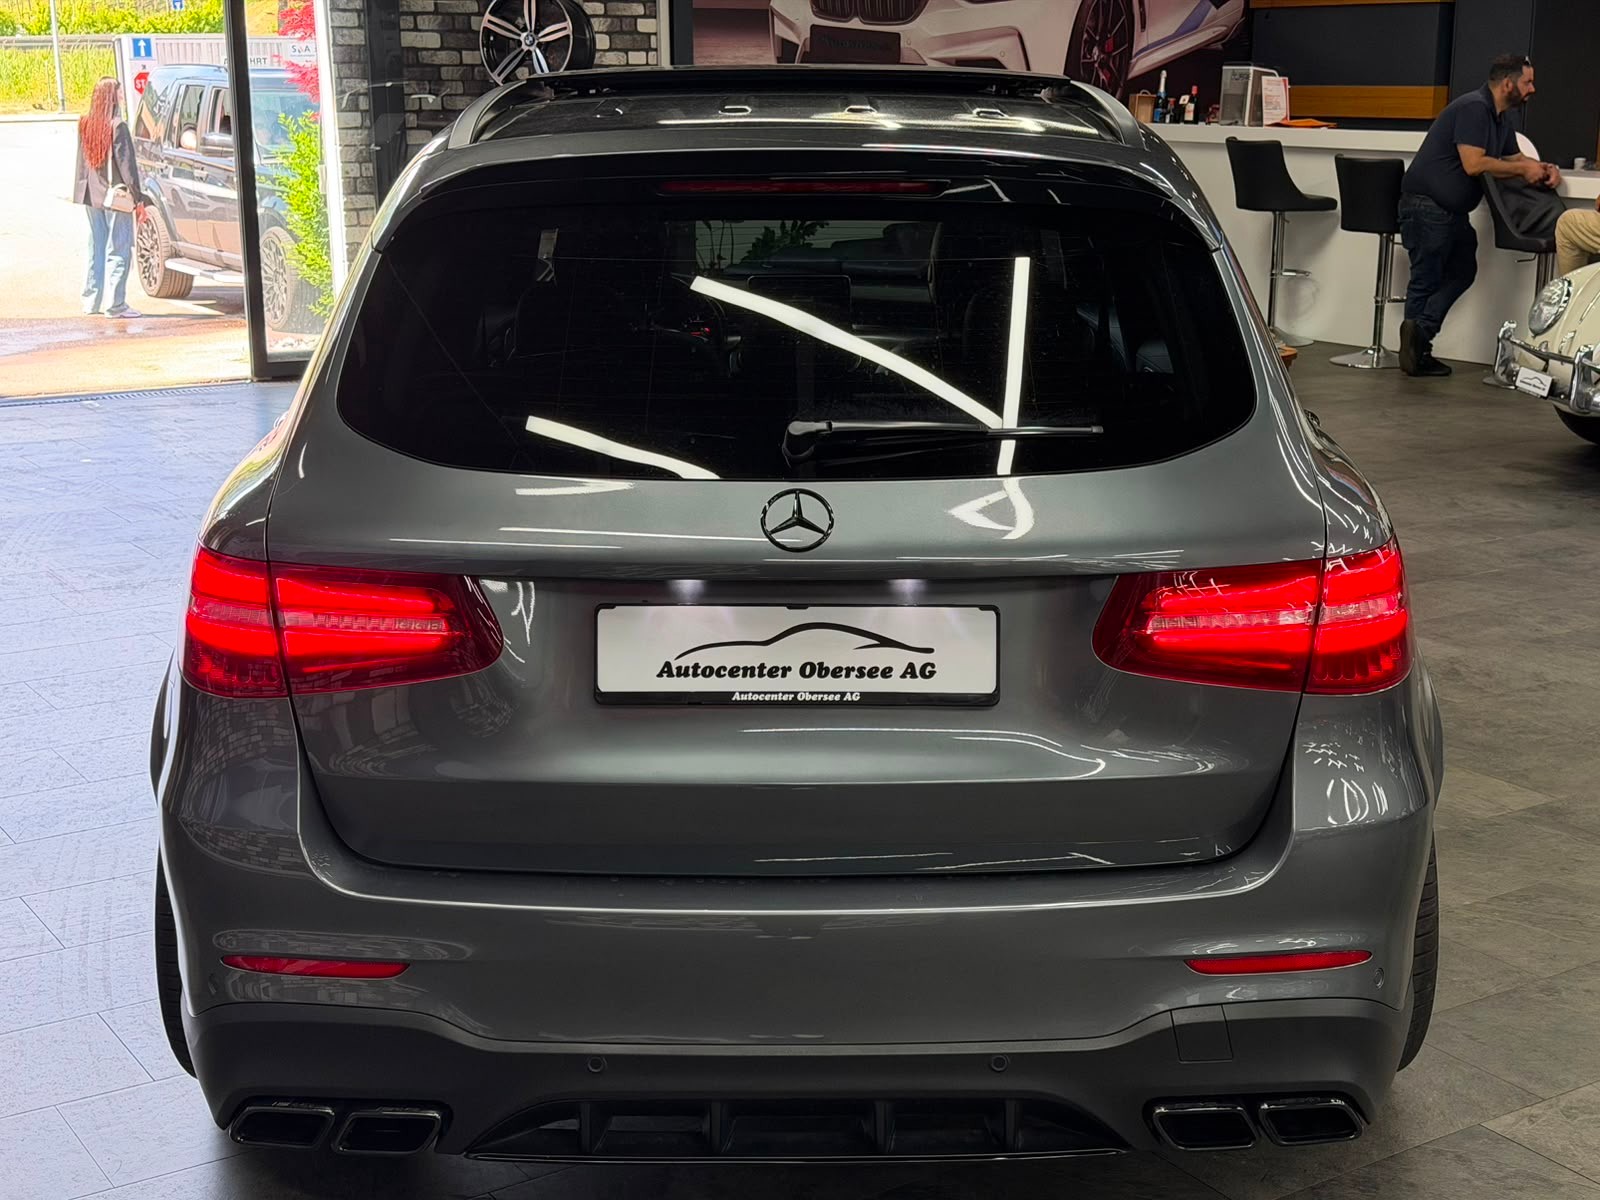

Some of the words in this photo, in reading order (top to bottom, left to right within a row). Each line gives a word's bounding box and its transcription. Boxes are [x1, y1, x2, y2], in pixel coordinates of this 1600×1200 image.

[656, 661, 792, 679] Autocenter
[799, 661, 894, 679] Obersee
[899, 662, 937, 680] AG
[732, 692, 794, 701] Autocenter
[797, 692, 841, 701] Obersee
[843, 692, 861, 701] AG
